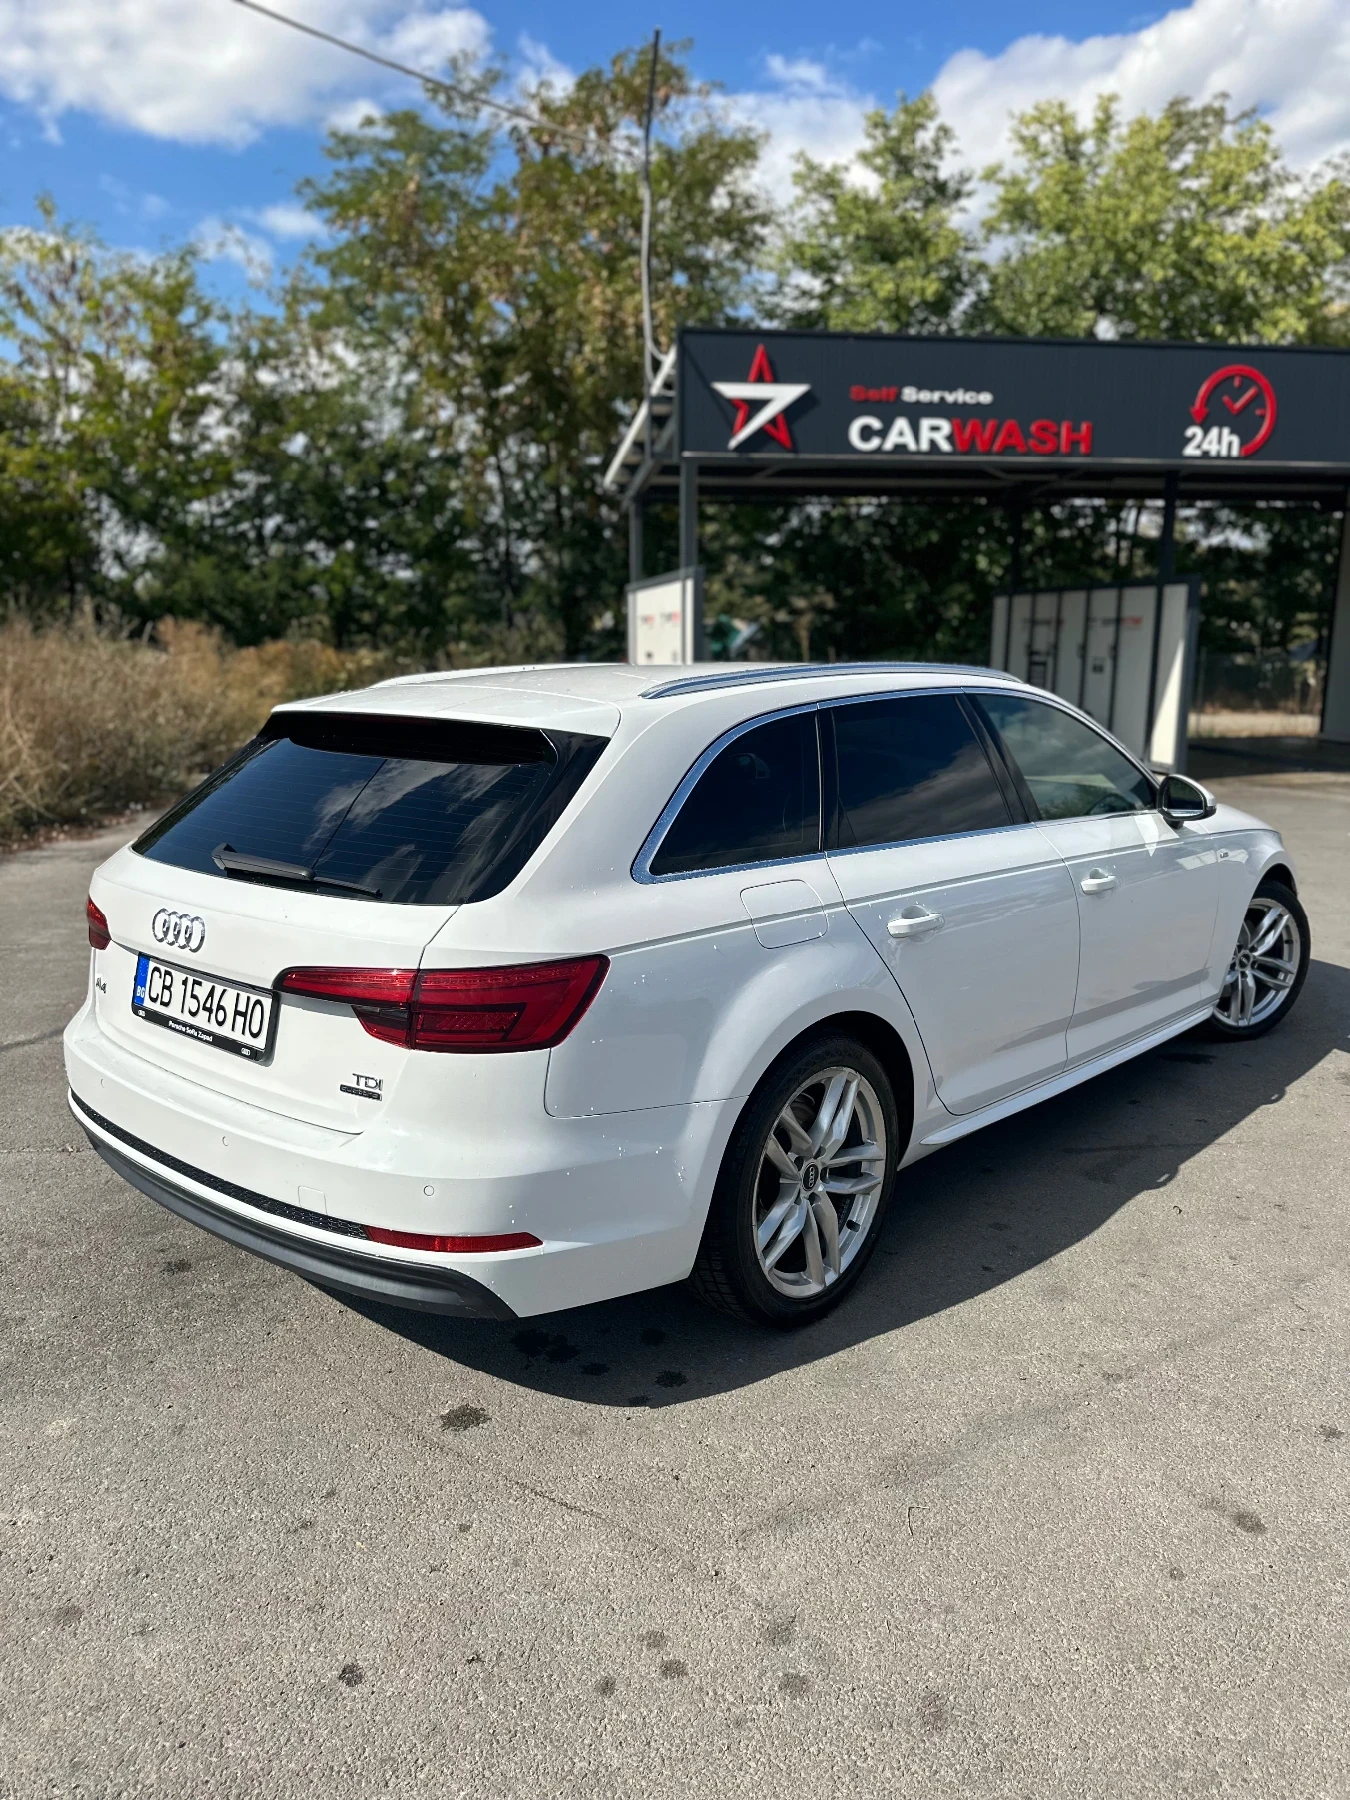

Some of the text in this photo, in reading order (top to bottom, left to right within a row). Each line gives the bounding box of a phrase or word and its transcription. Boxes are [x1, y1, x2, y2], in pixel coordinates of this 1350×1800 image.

[849, 384, 993, 405] Self Service
[1182, 425, 1241, 457] 24h
[136, 985, 146, 998] BG
[148, 965, 265, 1039] CB 1546 HO
[168, 1020, 186, 1032] Porsche
[198, 1031, 213, 1042] Zapad
[352, 1072, 384, 1091] TDI
